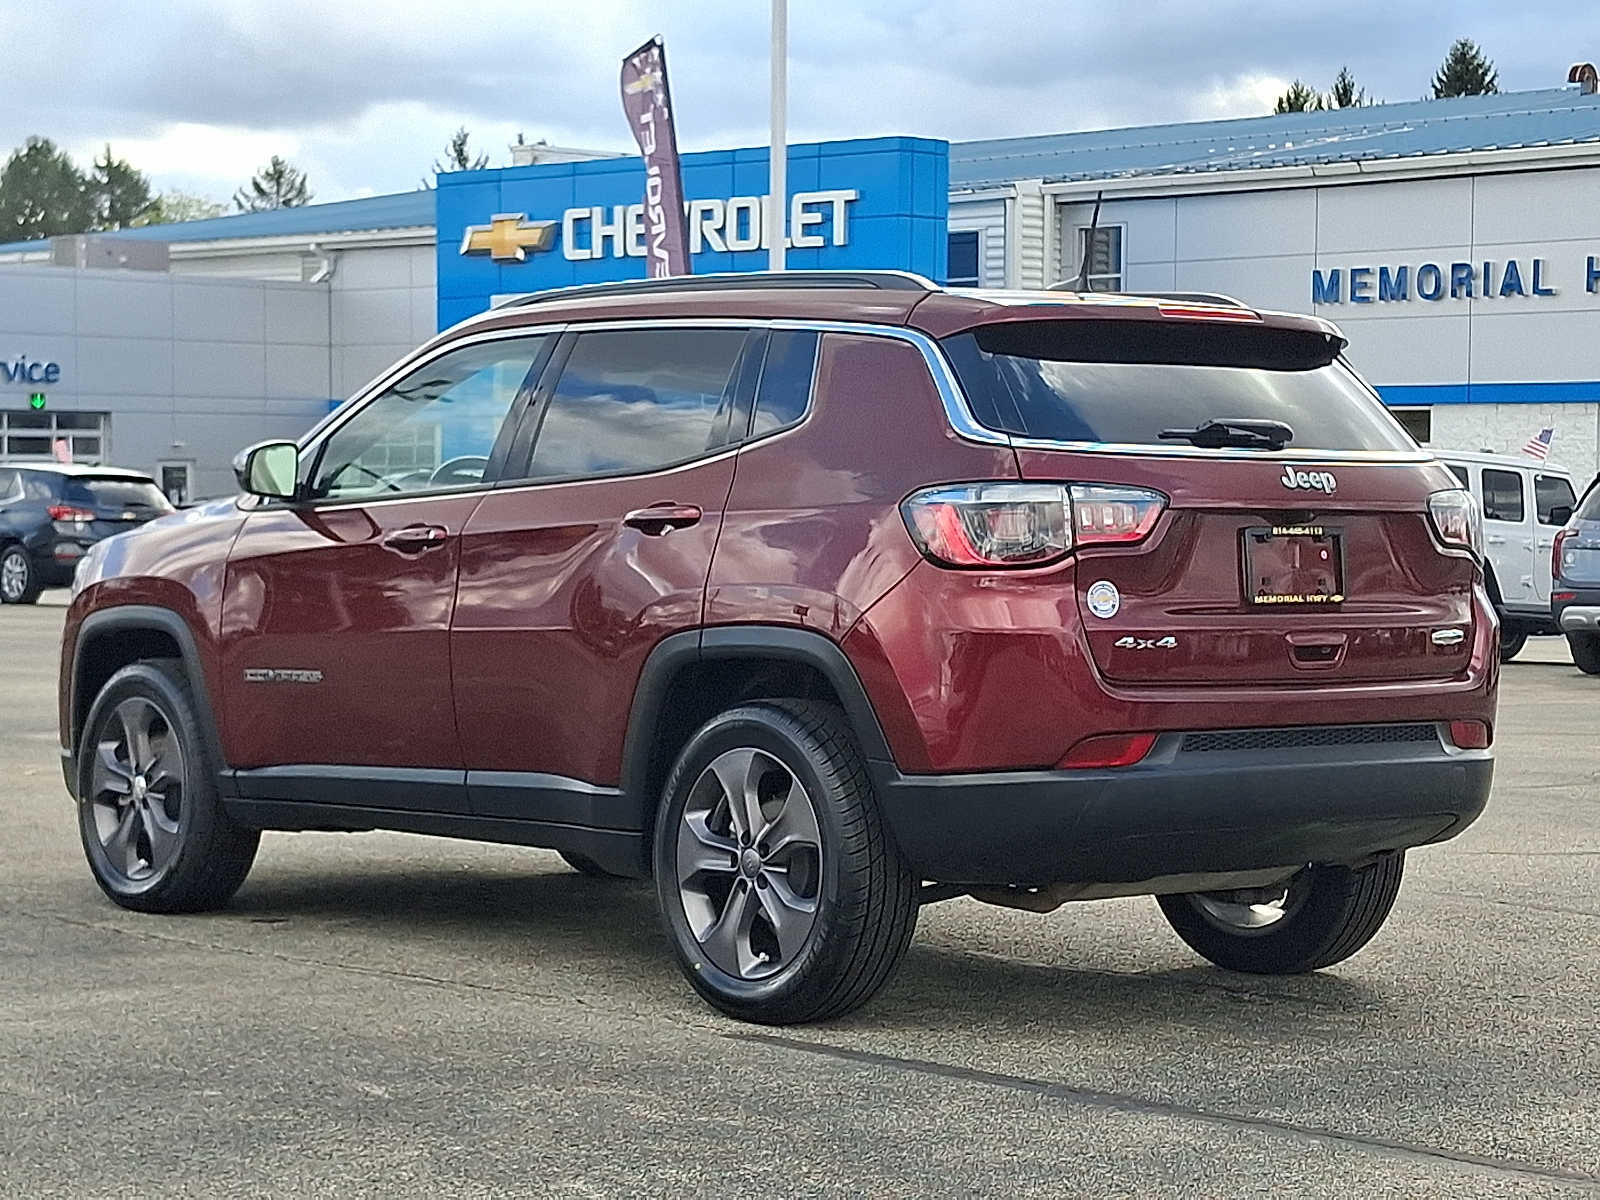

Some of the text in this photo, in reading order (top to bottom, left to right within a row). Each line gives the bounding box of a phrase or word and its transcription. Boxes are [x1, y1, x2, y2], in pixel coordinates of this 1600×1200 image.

[562, 189, 858, 261] CHEROLET
[1311, 257, 1555, 304] MEMORIAL
[1281, 465, 1337, 494] Jeep
[1254, 594, 1305, 604] MEMORIAL
